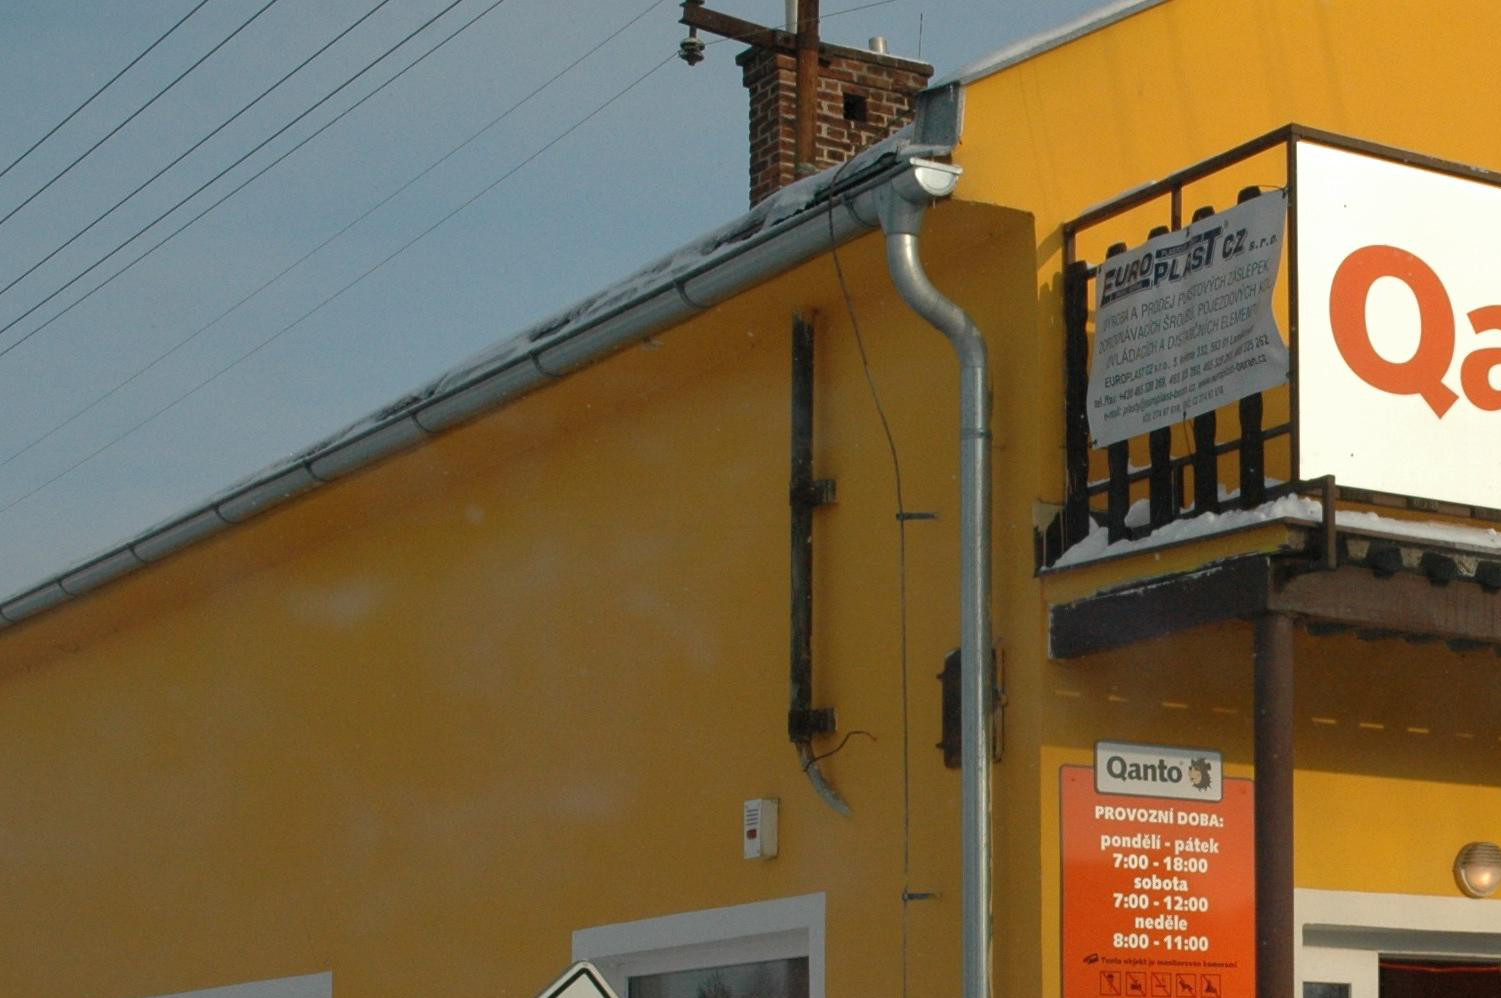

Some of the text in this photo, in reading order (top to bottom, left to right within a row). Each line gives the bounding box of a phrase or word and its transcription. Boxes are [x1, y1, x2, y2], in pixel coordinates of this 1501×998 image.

[1221, 228, 1247, 260] CZ
[1106, 756, 1183, 784] Qanto
[1095, 805, 1224, 828] PROVOZNÍ DOBA:
[1101, 833, 1160, 850] pondělí
[1175, 838, 1220, 855] pátek
[1113, 853, 1149, 870] 7:00
[1164, 857, 1208, 873] 18:00
[1134, 874, 1188, 892] sobota
[1113, 893, 1149, 909] 7:00
[1164, 897, 1208, 912] 12:00
[1135, 915, 1188, 930] neděle
[1113, 934, 1149, 949] 8:00
[1164, 937, 1209, 951] 11:00
